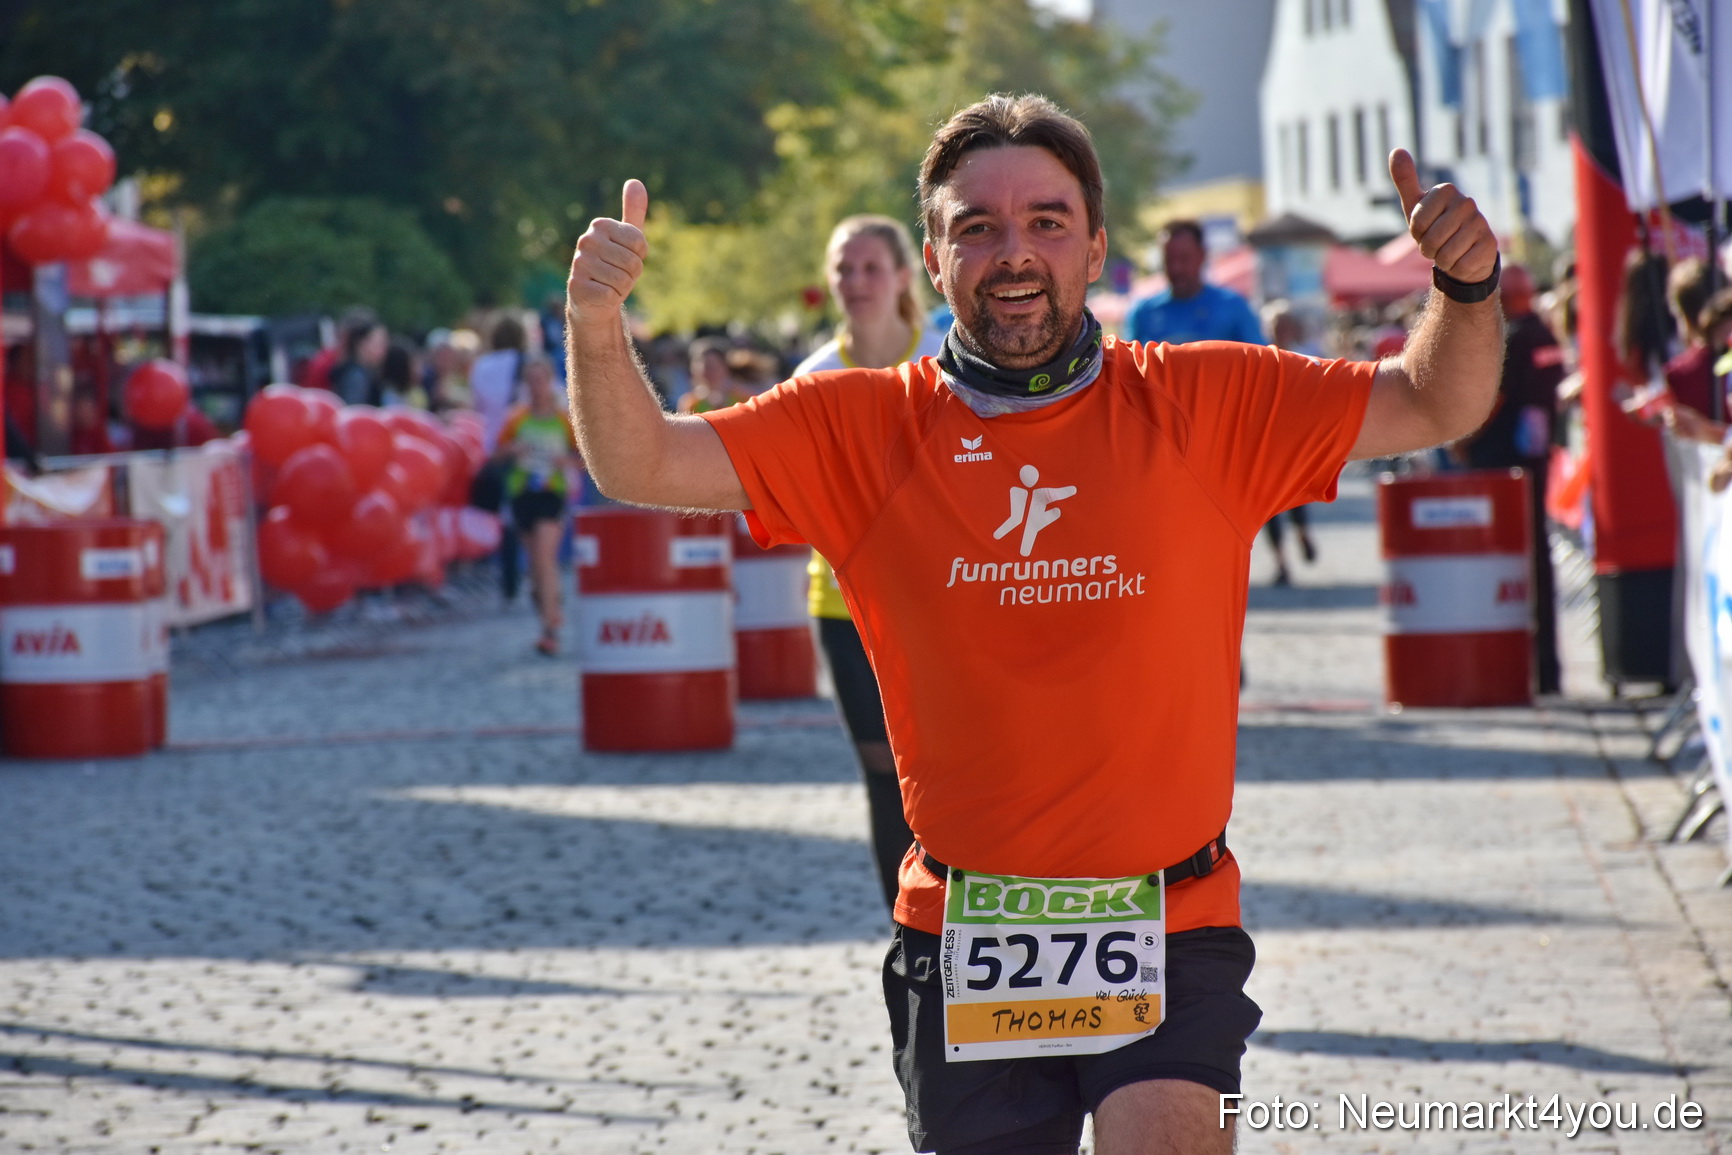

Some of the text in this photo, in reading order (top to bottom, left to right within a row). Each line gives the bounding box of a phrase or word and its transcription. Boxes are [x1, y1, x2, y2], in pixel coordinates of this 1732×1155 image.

[954, 450, 993, 463] erima
[946, 554, 1117, 588] funrunners
[999, 572, 1146, 606] neumarkt
[11, 624, 83, 656] AVIA
[597, 613, 672, 647] AVIA
[964, 876, 1145, 919] BOCK
[1144, 935, 1154, 946] S
[966, 931, 1138, 990] 5276
[992, 1005, 1102, 1035] THOMAS
